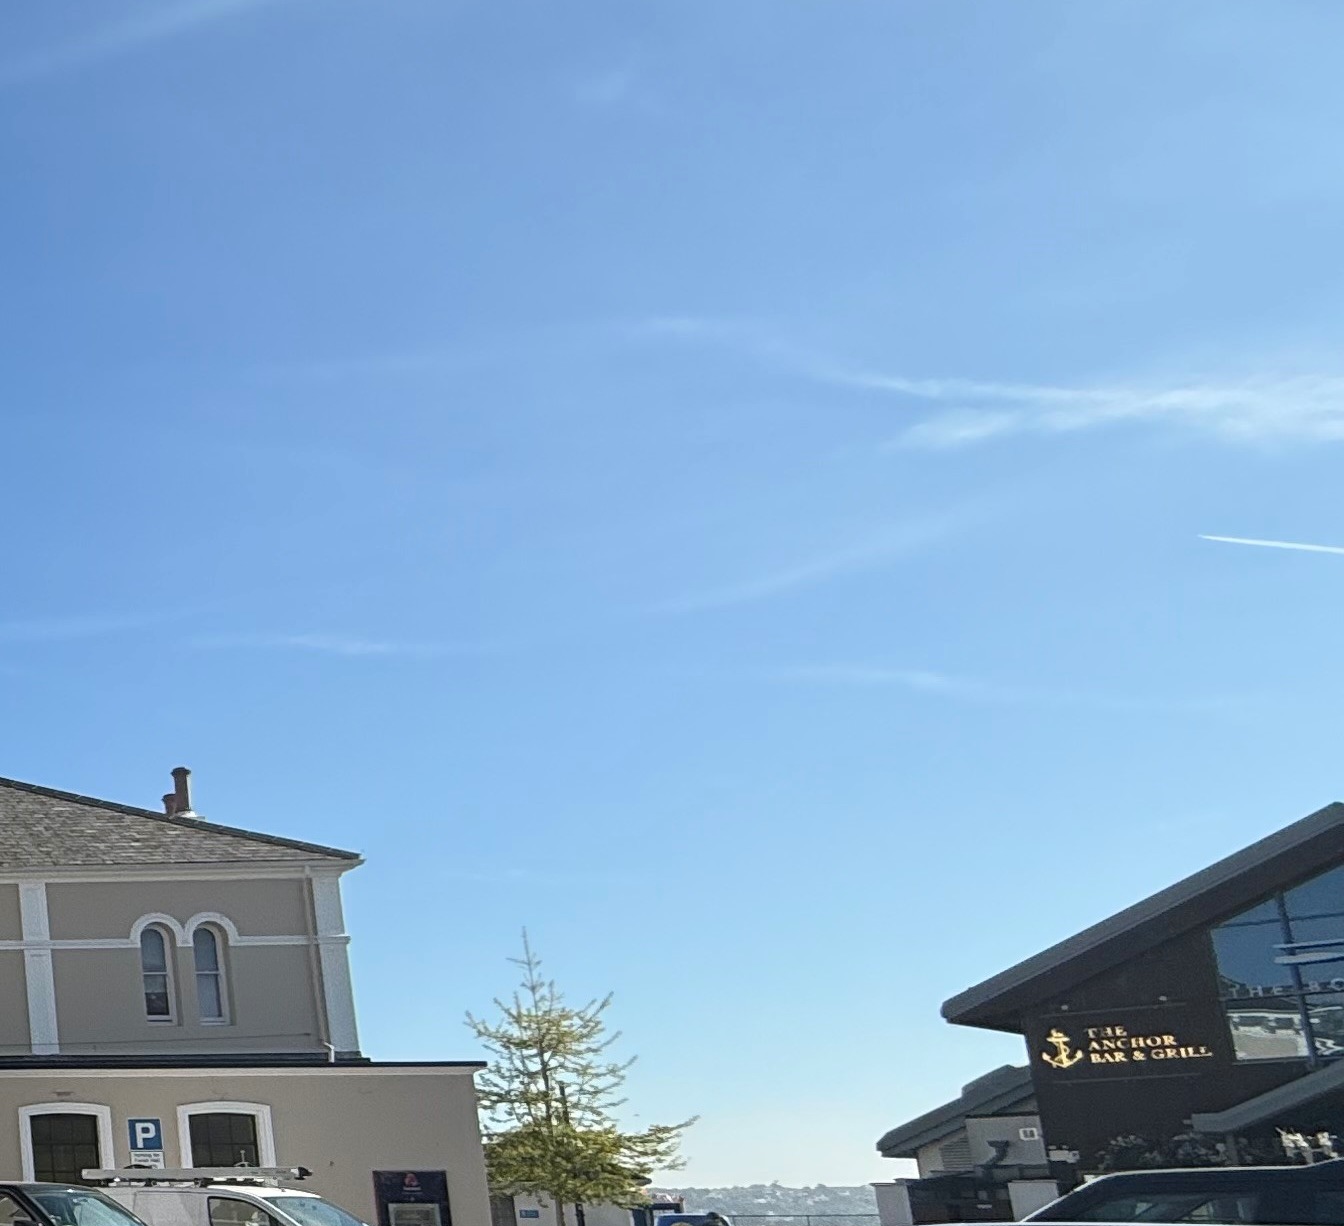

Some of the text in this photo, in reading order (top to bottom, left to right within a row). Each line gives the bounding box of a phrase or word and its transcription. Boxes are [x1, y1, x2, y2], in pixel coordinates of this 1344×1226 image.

[1083, 1025, 1127, 1039] THE
[1089, 1035, 1177, 1051] ANCHOR
[1090, 1046, 1212, 1064] BAR & GRILL
[135, 1122, 156, 1149] P
